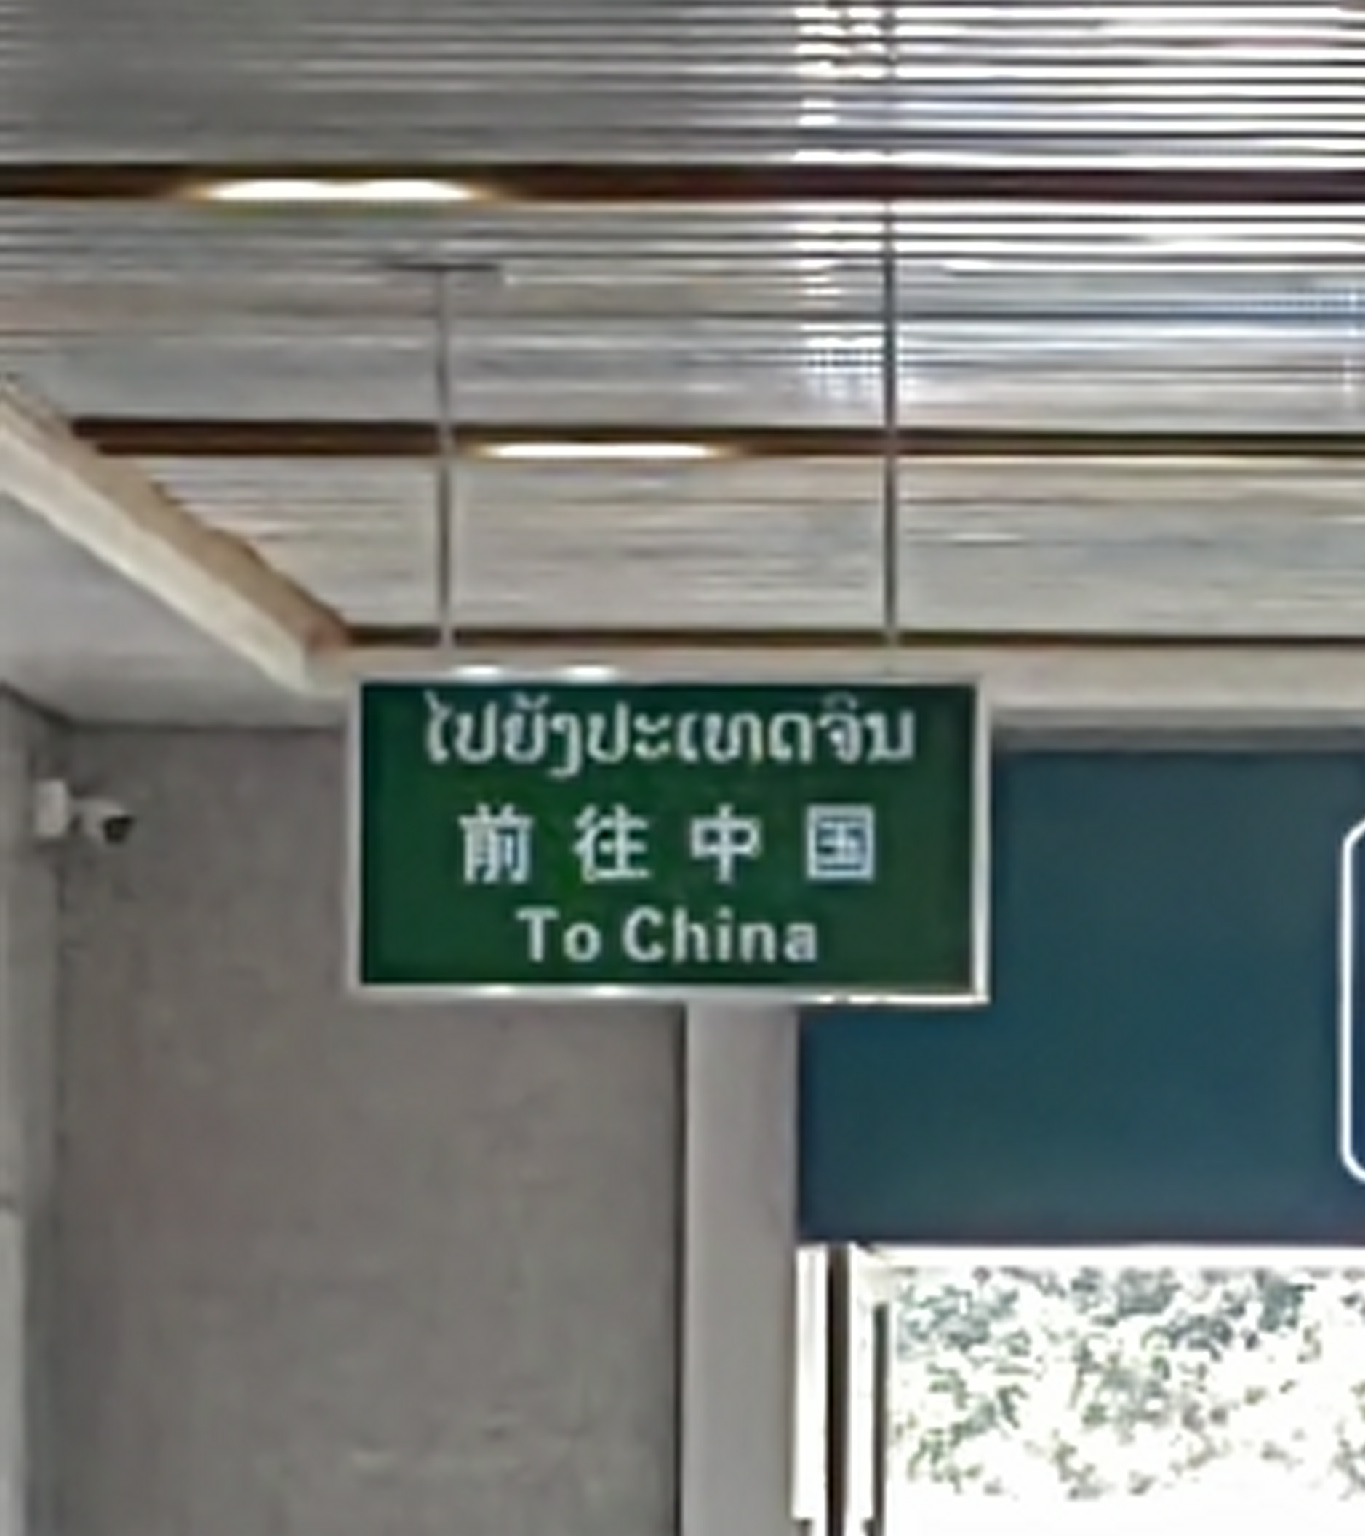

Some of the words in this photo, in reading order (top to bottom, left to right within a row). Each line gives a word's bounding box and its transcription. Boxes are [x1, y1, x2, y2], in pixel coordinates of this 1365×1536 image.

[458, 802, 876, 885] 前往中国
[515, 906, 602, 963] To
[622, 904, 818, 963] China
